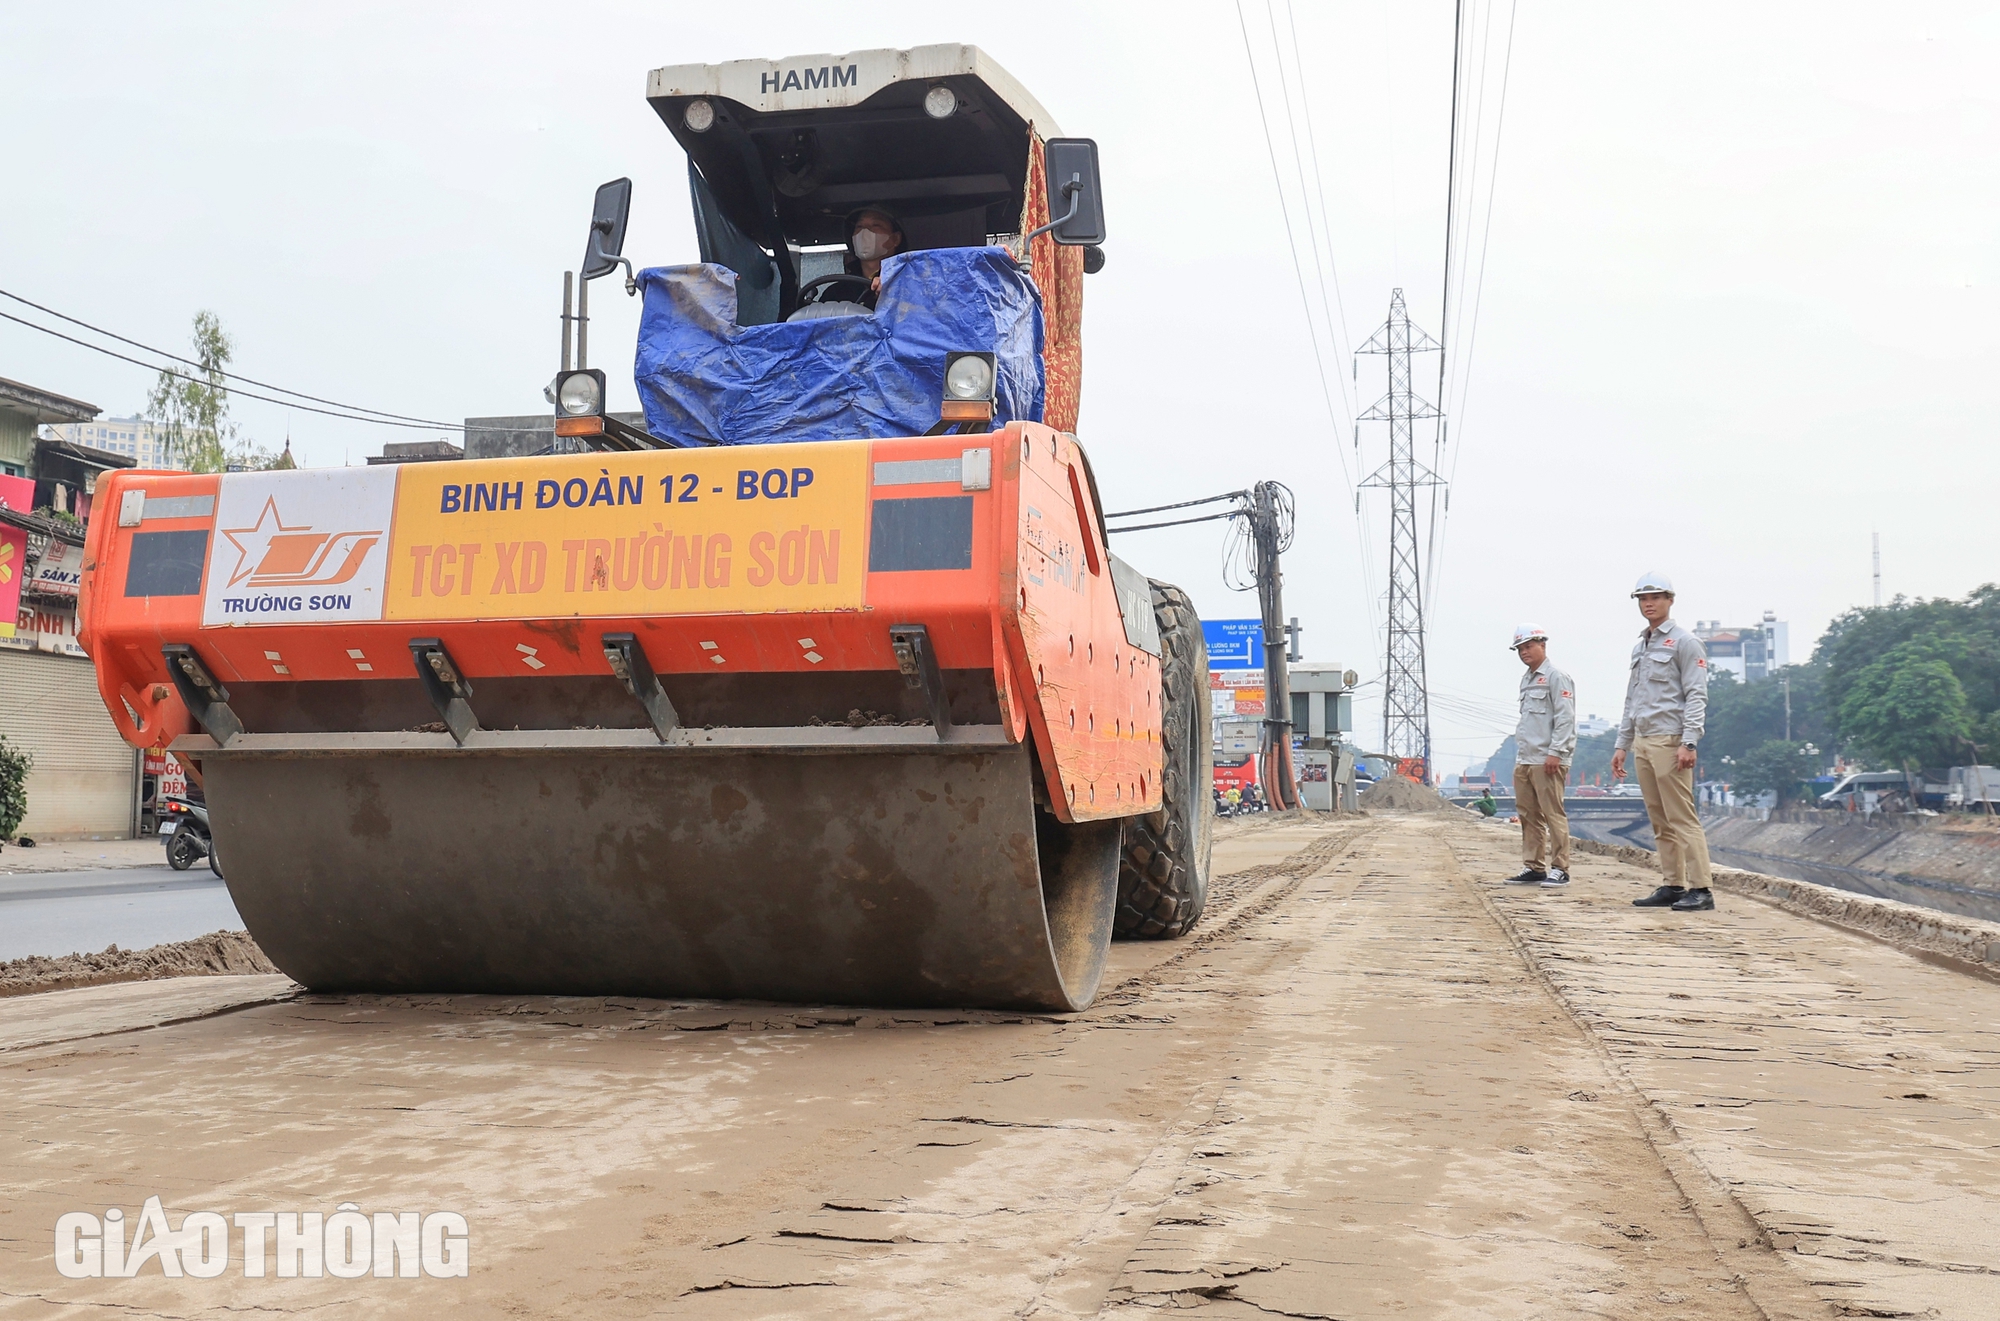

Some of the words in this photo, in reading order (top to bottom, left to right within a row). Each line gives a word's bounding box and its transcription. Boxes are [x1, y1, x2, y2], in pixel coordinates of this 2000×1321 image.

[761, 64, 857, 94] HAMM
[440, 481, 523, 514] BINH
[535, 468, 644, 510] ĐOÀN
[659, 473, 699, 504] 12
[736, 467, 814, 500] BQP
[40, 567, 69, 582] SẢN
[410, 543, 481, 598] TCT
[489, 541, 547, 595] XD
[561, 523, 732, 593] TRƯỜNG
[747, 524, 841, 587] SƠN
[222, 596, 302, 614] TRƯỜNG
[308, 594, 352, 612] SƠN
